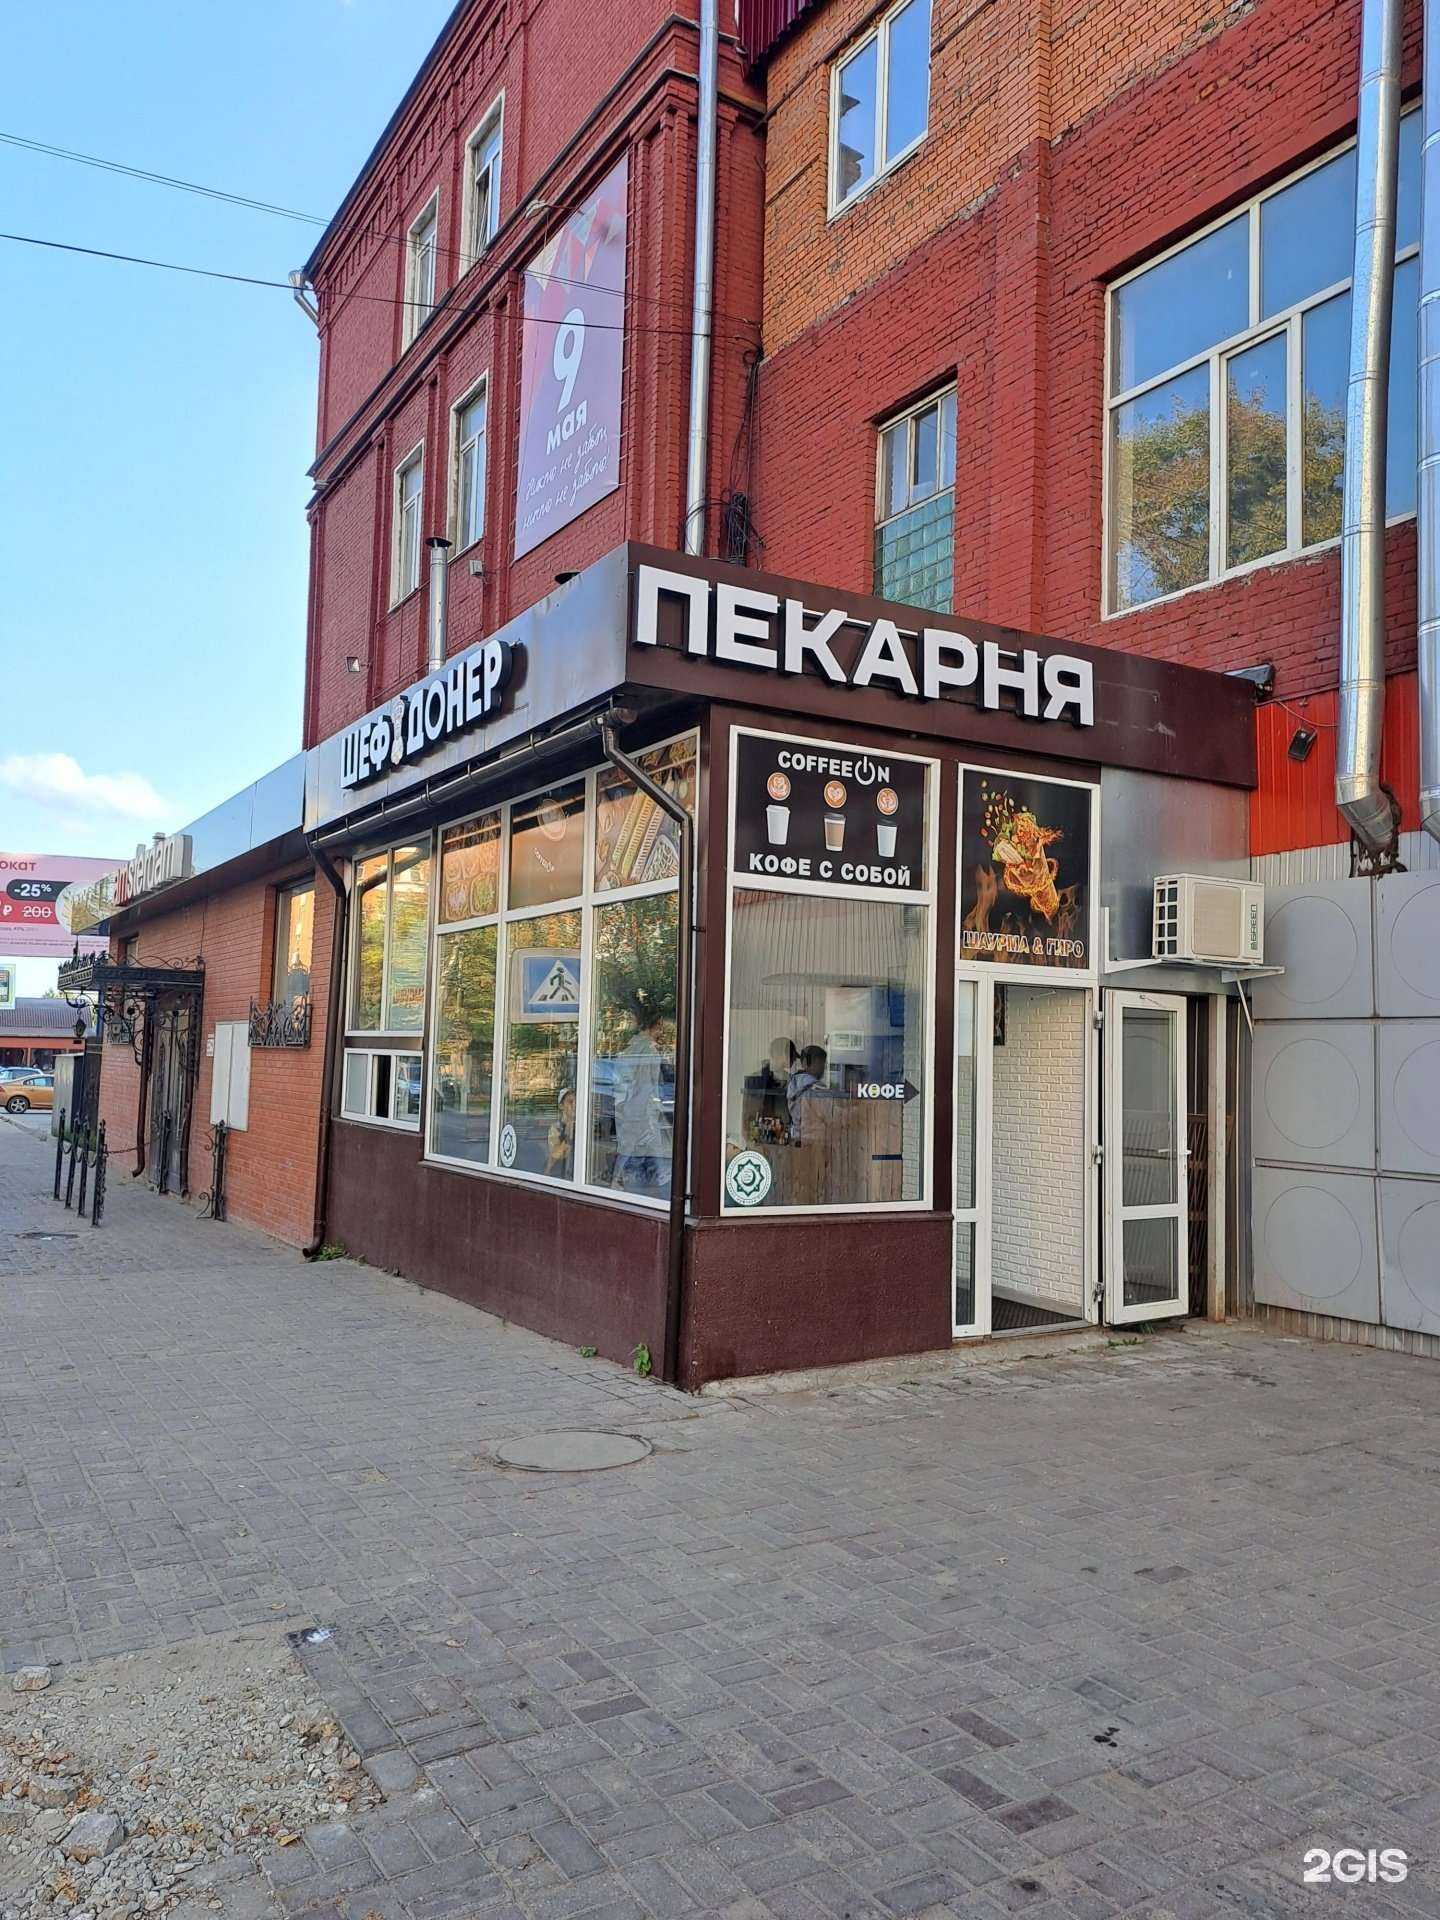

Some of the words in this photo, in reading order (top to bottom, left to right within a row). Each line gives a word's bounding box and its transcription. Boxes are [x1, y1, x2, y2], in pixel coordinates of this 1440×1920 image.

[552, 308, 586, 414] 9
[636, 564, 1095, 727] ПЕКАРНЯ
[340, 714, 391, 789] ШЕФ
[406, 639, 504, 756] ДОНЕР
[750, 853, 811, 876] КОФЕ
[819, 860, 833, 878] С
[841, 863, 911, 886] СОБОЙ
[14, 883, 52, 898] -25%
[22, 905, 53, 918] 200
[963, 930, 1029, 953] ШАУРМА
[857, 1083, 905, 1100] КОФЕ
